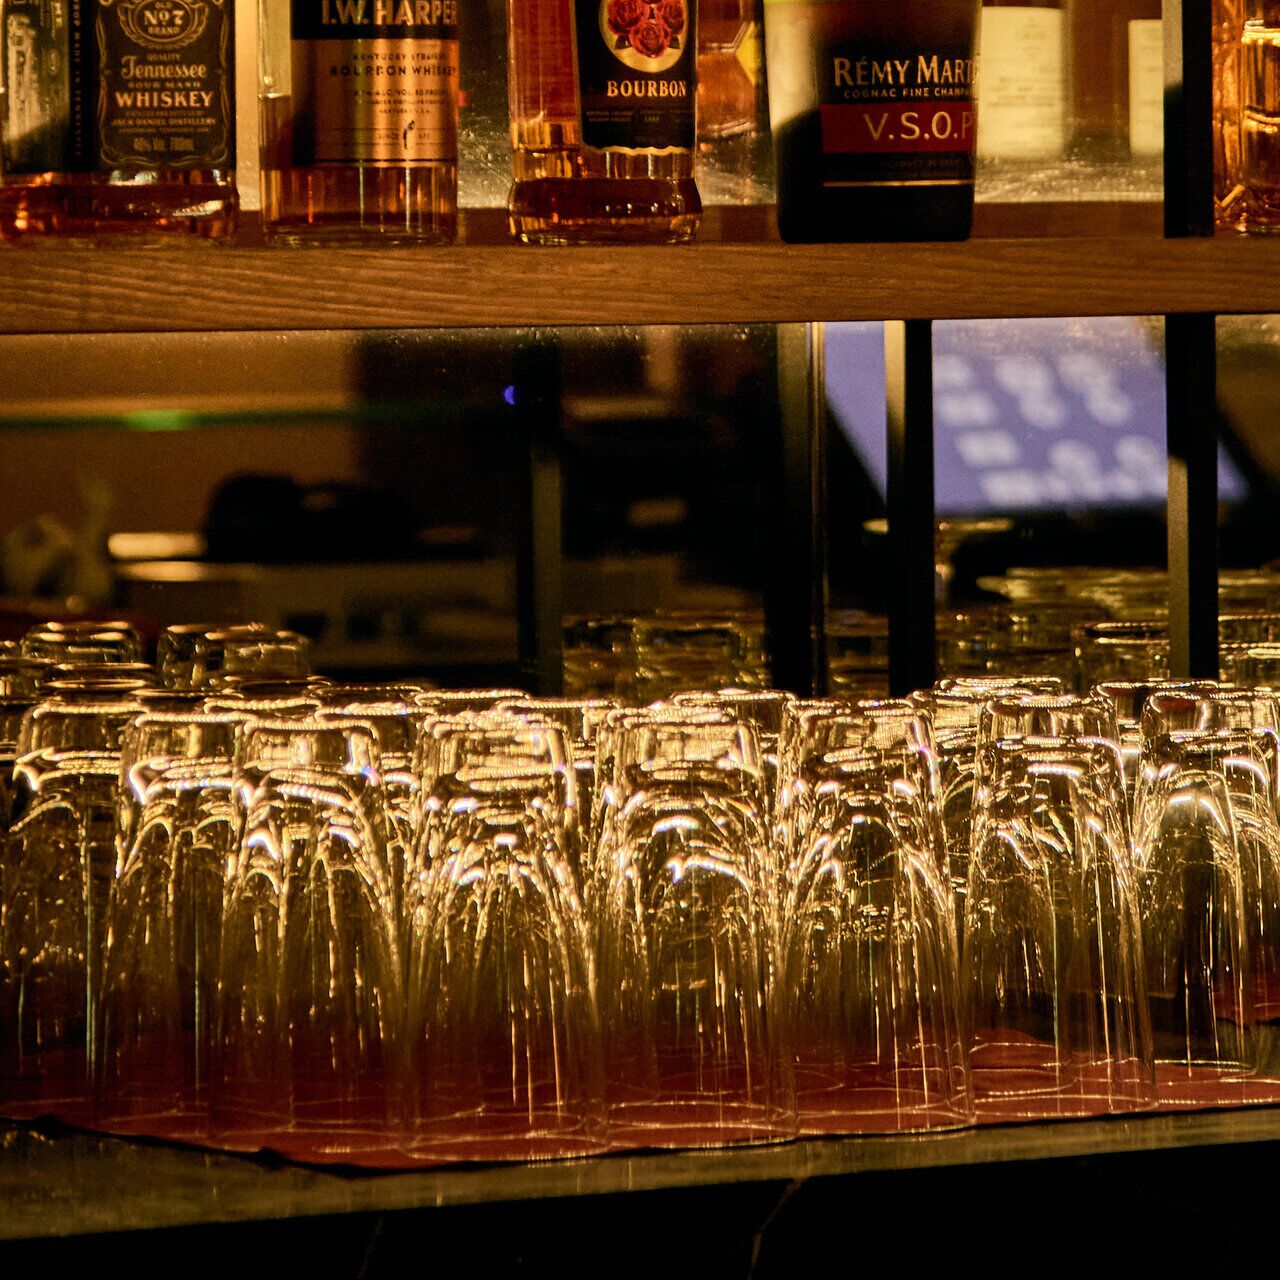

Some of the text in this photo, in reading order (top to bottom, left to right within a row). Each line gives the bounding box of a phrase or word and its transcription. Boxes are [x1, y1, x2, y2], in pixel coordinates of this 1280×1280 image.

[322, 0, 370, 25] I.W.
[121, 55, 207, 79] Tennessee
[833, 54, 911, 87] RÉMY
[606, 80, 687, 97] BOURBON
[844, 88, 897, 100] COGNAC
[902, 87, 930, 98] FINE
[114, 91, 214, 108] WHISKEY
